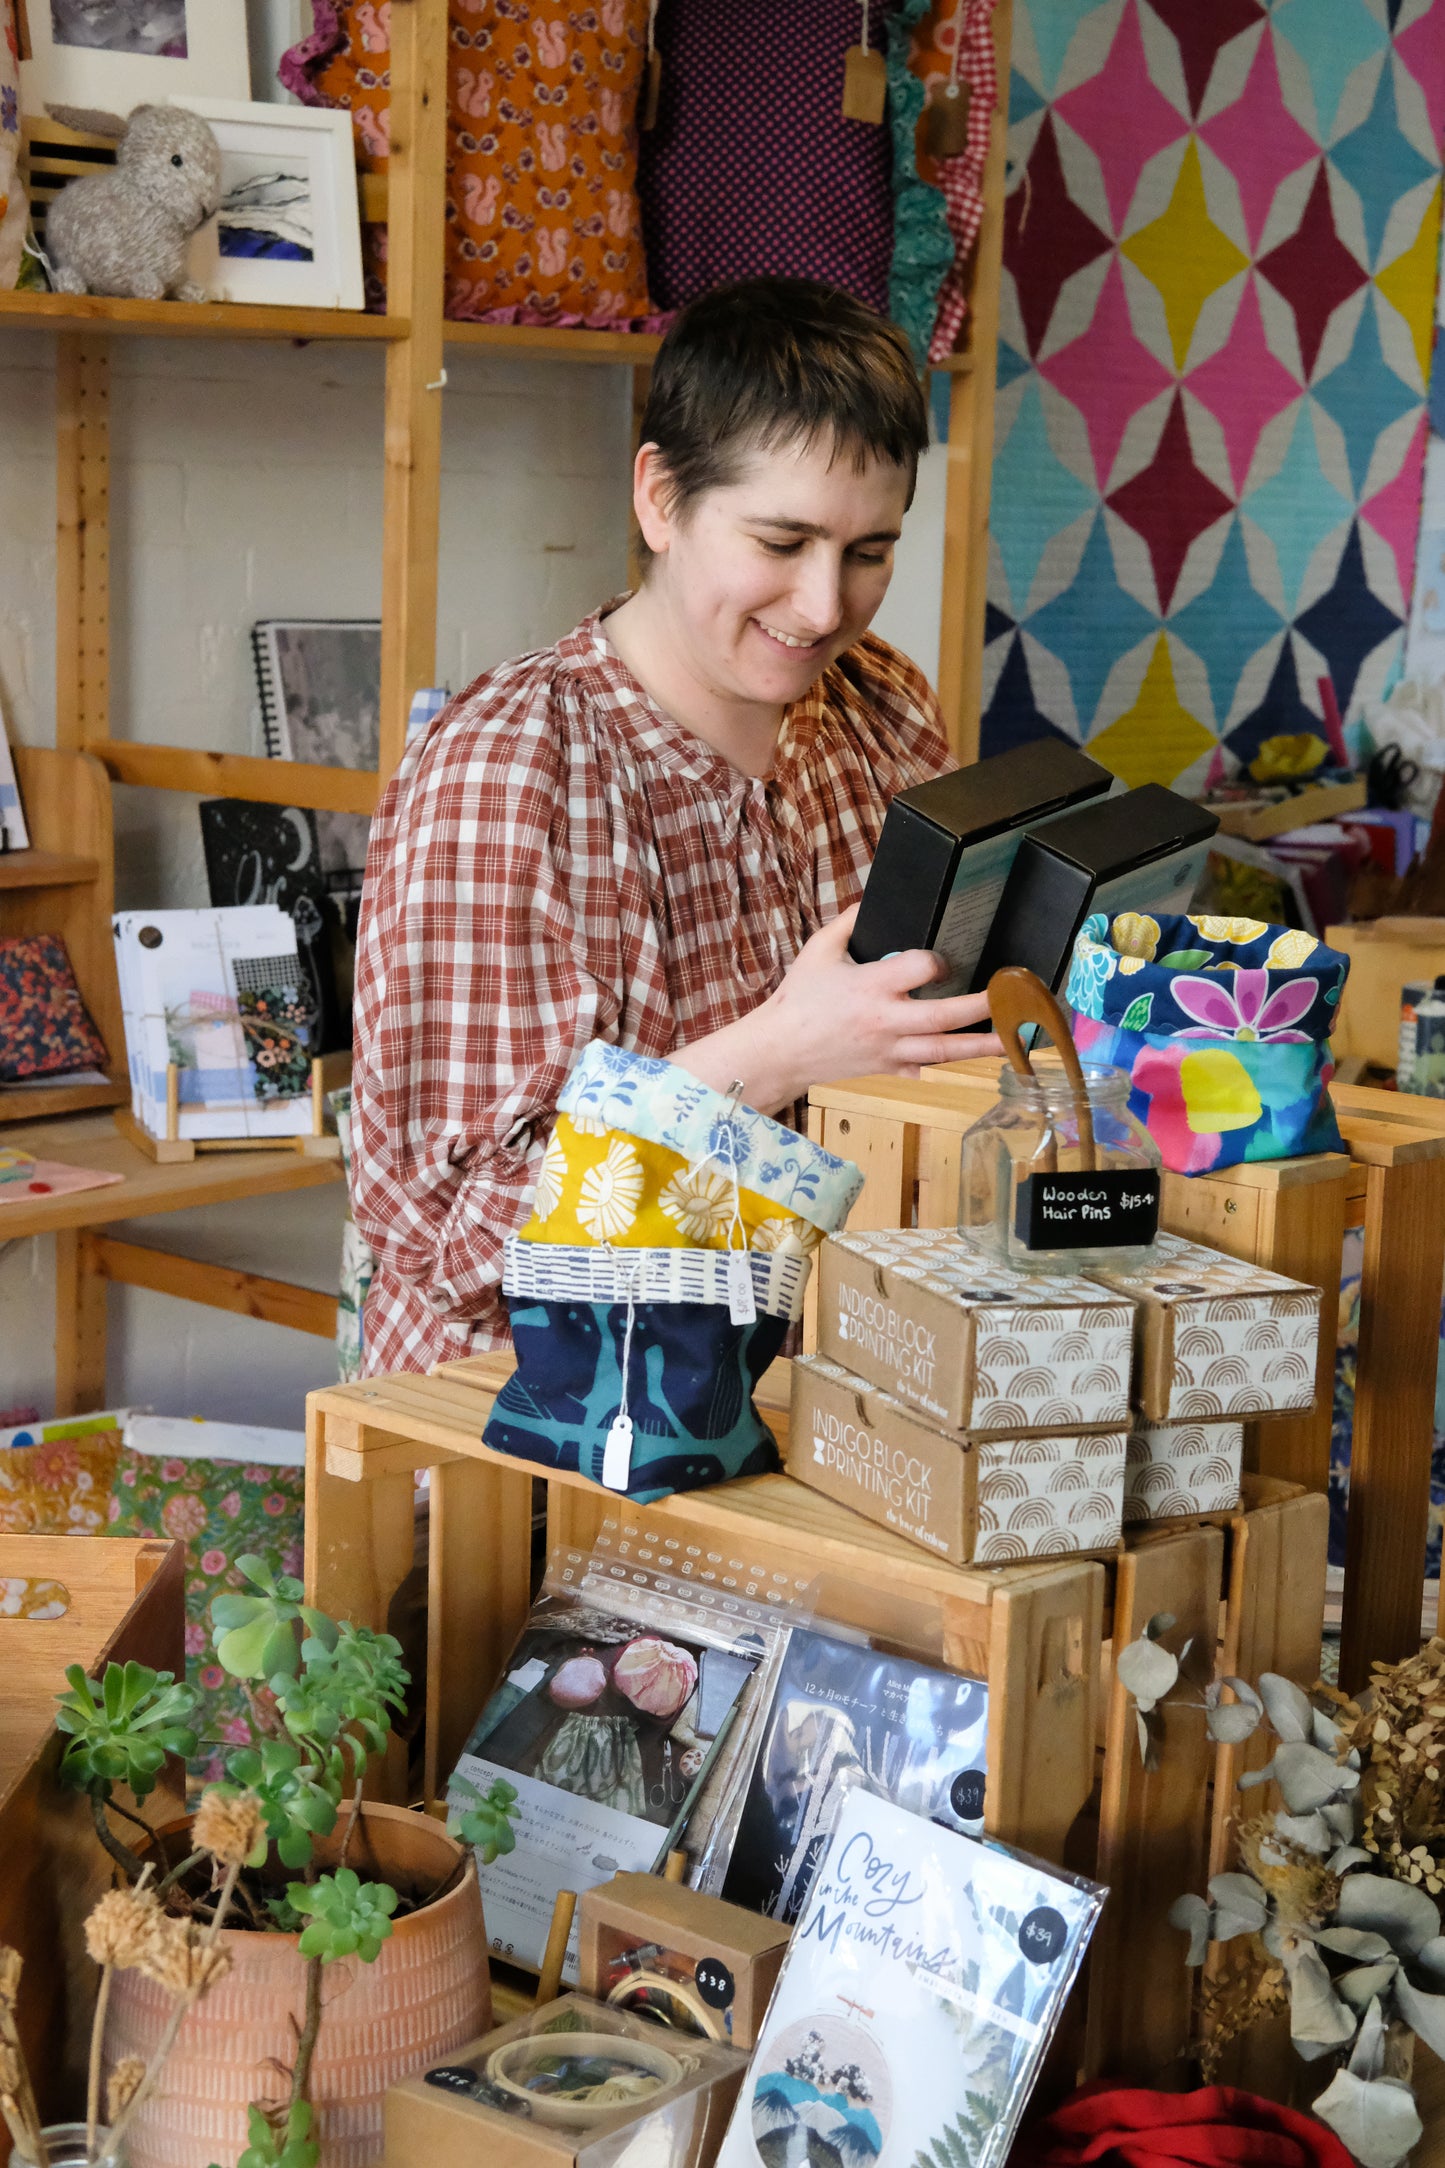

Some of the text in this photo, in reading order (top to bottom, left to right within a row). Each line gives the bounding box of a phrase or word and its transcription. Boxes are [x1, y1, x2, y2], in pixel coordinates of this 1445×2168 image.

[1043, 1187, 1107, 1202] Wooden
[1043, 1205, 1111, 1220] Hair Pins
[838, 1282, 936, 1360] INDIGO BLOCK
[849, 1317, 936, 1390] PRINTING KIT
[812, 1407, 932, 1494] INDIGO BLOCK
[827, 1442, 932, 1522] PRINTING KIT
[956, 1786, 980, 1806] $39
[819, 1884, 859, 1906] in the
[837, 1832, 926, 1917] Cozy
[801, 1904, 958, 1974] Mountains
[1025, 1920, 1052, 1947] $39
[699, 1970, 726, 1991] $38
